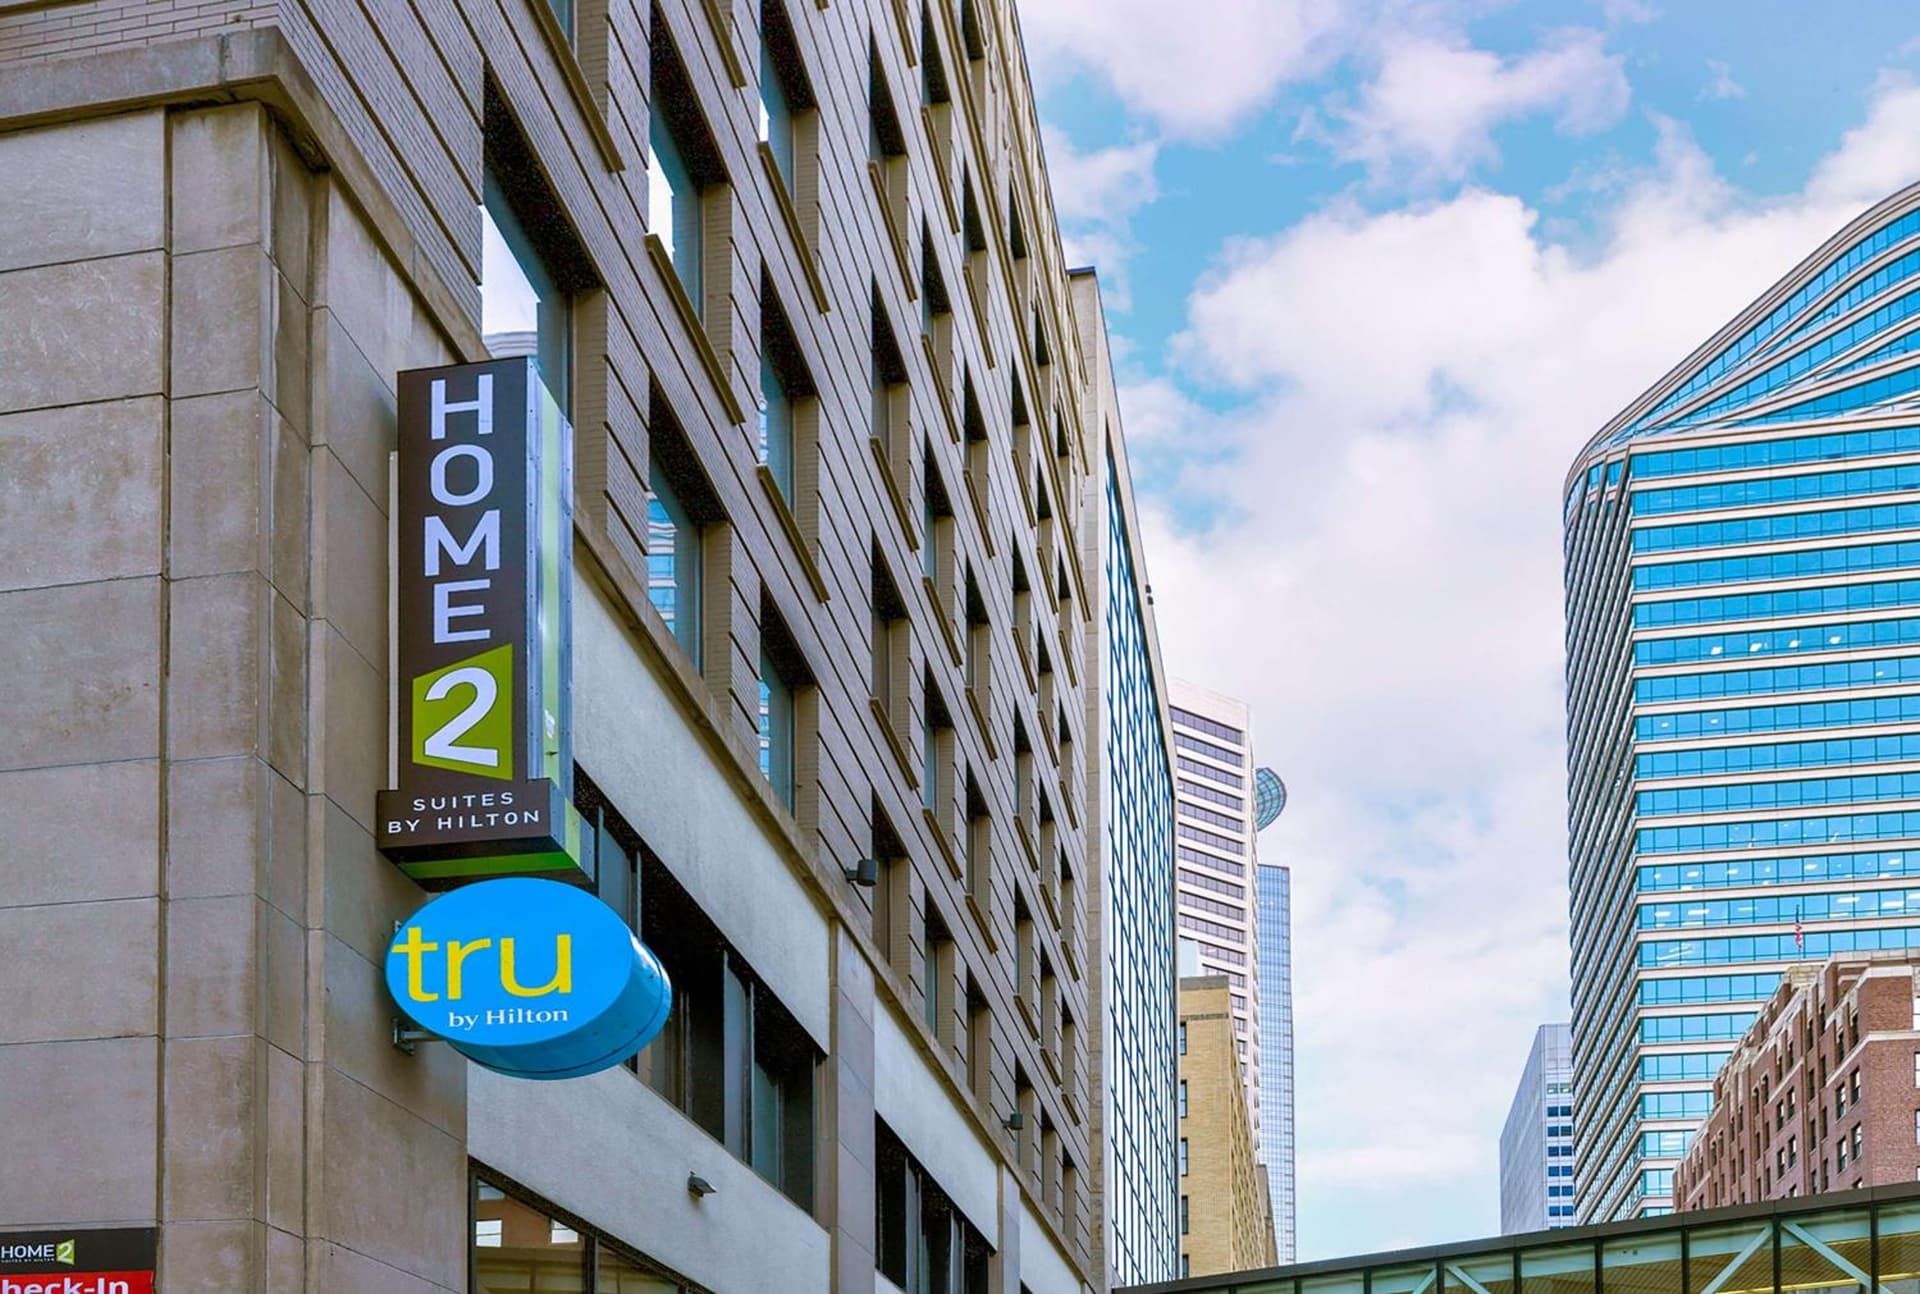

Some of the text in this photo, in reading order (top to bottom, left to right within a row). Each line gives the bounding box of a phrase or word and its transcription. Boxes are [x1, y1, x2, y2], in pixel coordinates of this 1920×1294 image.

[412, 791, 514, 812] SUITES
[387, 809, 540, 835] BY HILTON
[391, 926, 573, 1003] tru
[448, 1007, 569, 1031] by Hilton
[1, 1277, 129, 1294] heck-In
